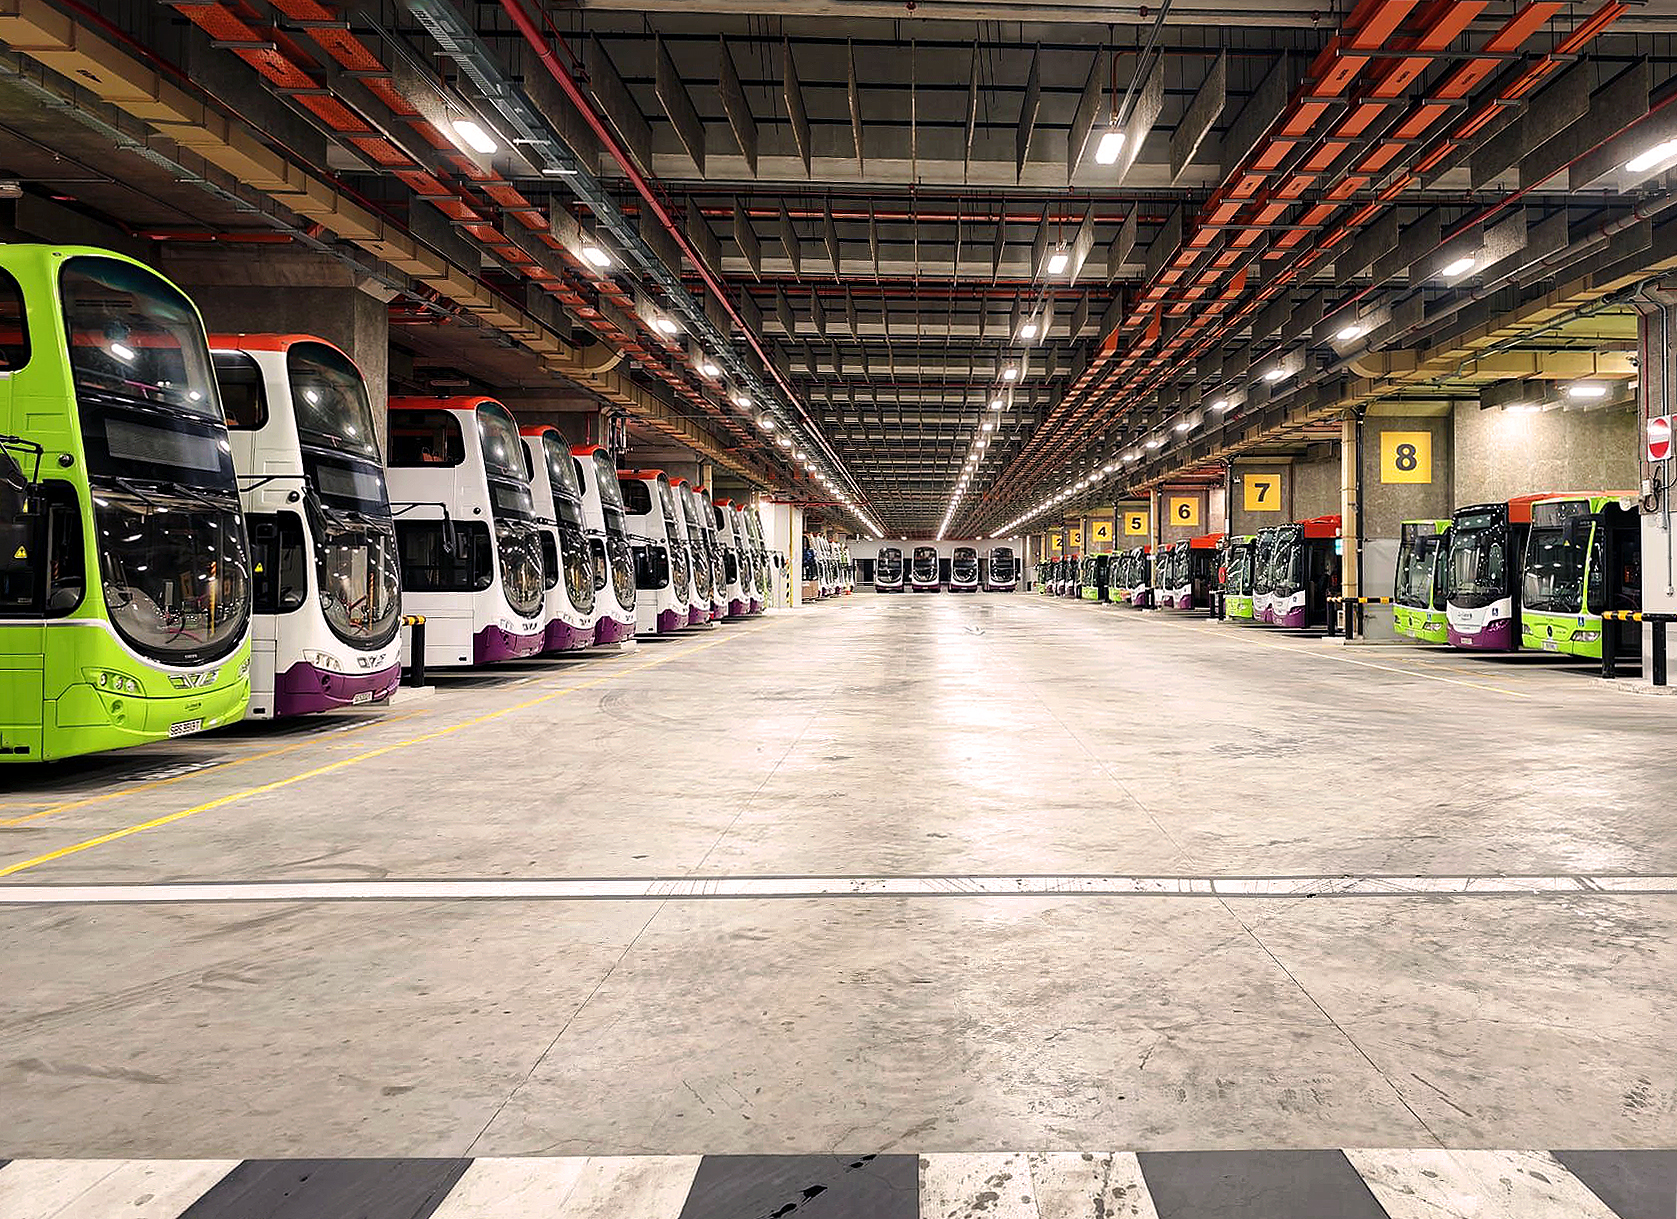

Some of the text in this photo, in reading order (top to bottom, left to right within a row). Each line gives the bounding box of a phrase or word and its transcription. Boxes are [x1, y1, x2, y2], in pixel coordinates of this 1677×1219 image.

[1396, 444, 1417, 471] 8
[1254, 482, 1271, 503] 7
[1178, 503, 1191, 519] 6
[1131, 517, 1142, 530] 5
[1075, 533, 1081, 543] 3
[1097, 526, 1107, 537] 4
[1056, 538, 1063, 547] 2
